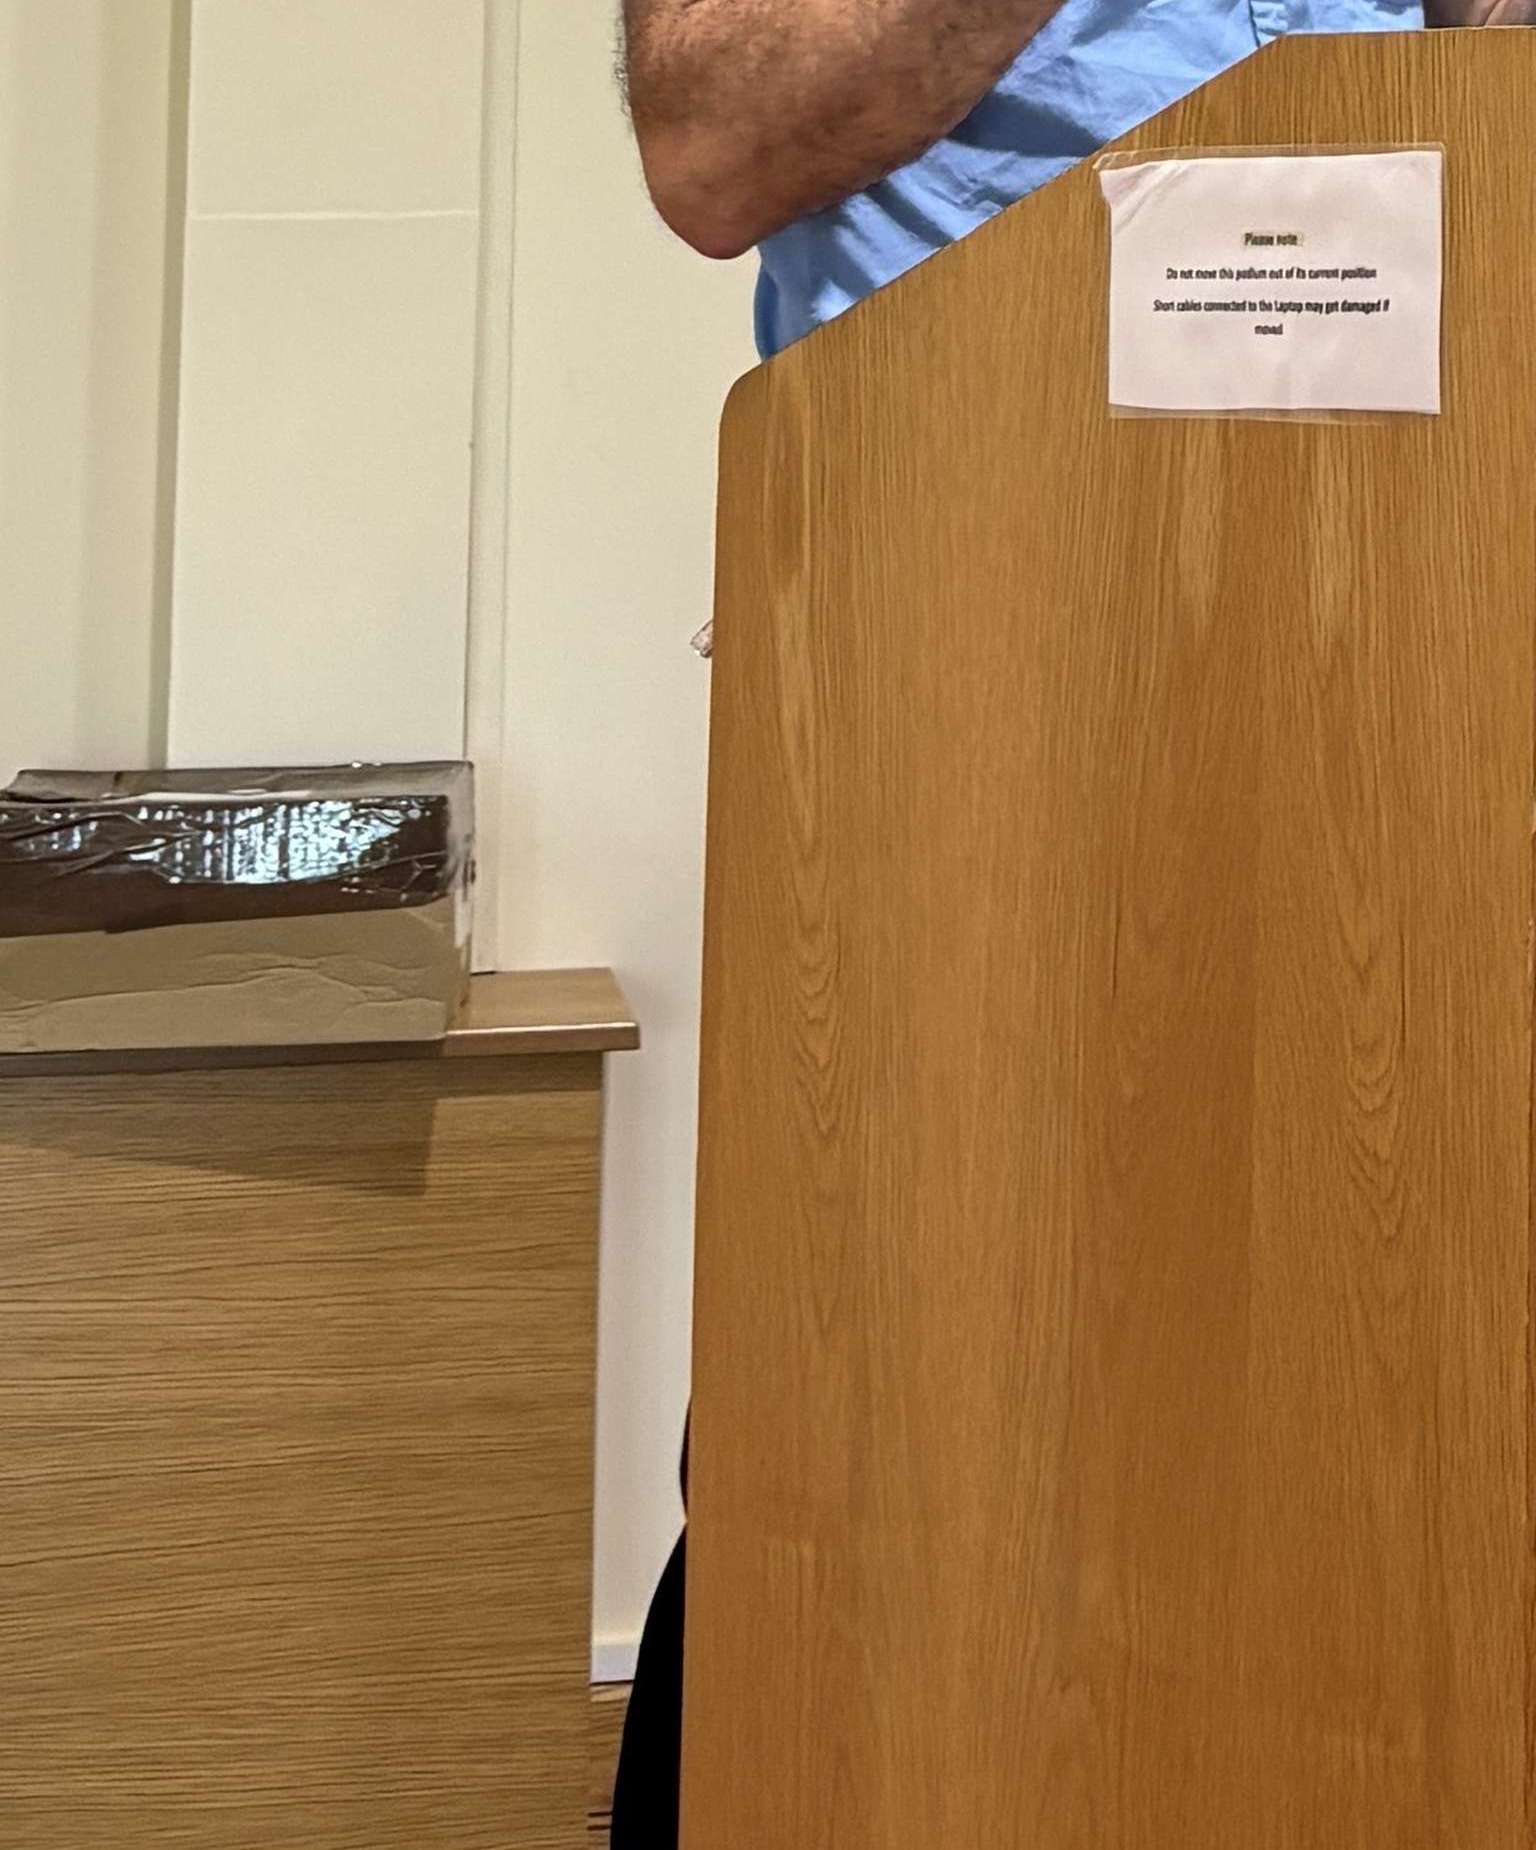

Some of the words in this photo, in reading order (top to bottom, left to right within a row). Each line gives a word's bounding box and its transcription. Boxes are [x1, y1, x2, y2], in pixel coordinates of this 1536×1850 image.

[1244, 232, 1274, 246] Please
[1166, 267, 1178, 280] Do
[1180, 269, 1194, 279] not
[1195, 269, 1217, 279] move
[1219, 267, 1234, 279] this
[1236, 267, 1267, 281] podium
[1268, 269, 1283, 279] out
[1285, 266, 1295, 279] of
[1296, 267, 1306, 279] its
[1308, 268, 1339, 279] current
[1341, 267, 1377, 281] position
[1153, 299, 1175, 312] Short
[1176, 298, 1202, 312] cables
[1203, 299, 1247, 312] connected
[1248, 300, 1257, 312] to
[1258, 299, 1273, 312] the
[1305, 301, 1323, 314] may
[1325, 300, 1339, 315] get
[1341, 298, 1381, 315] damaged
